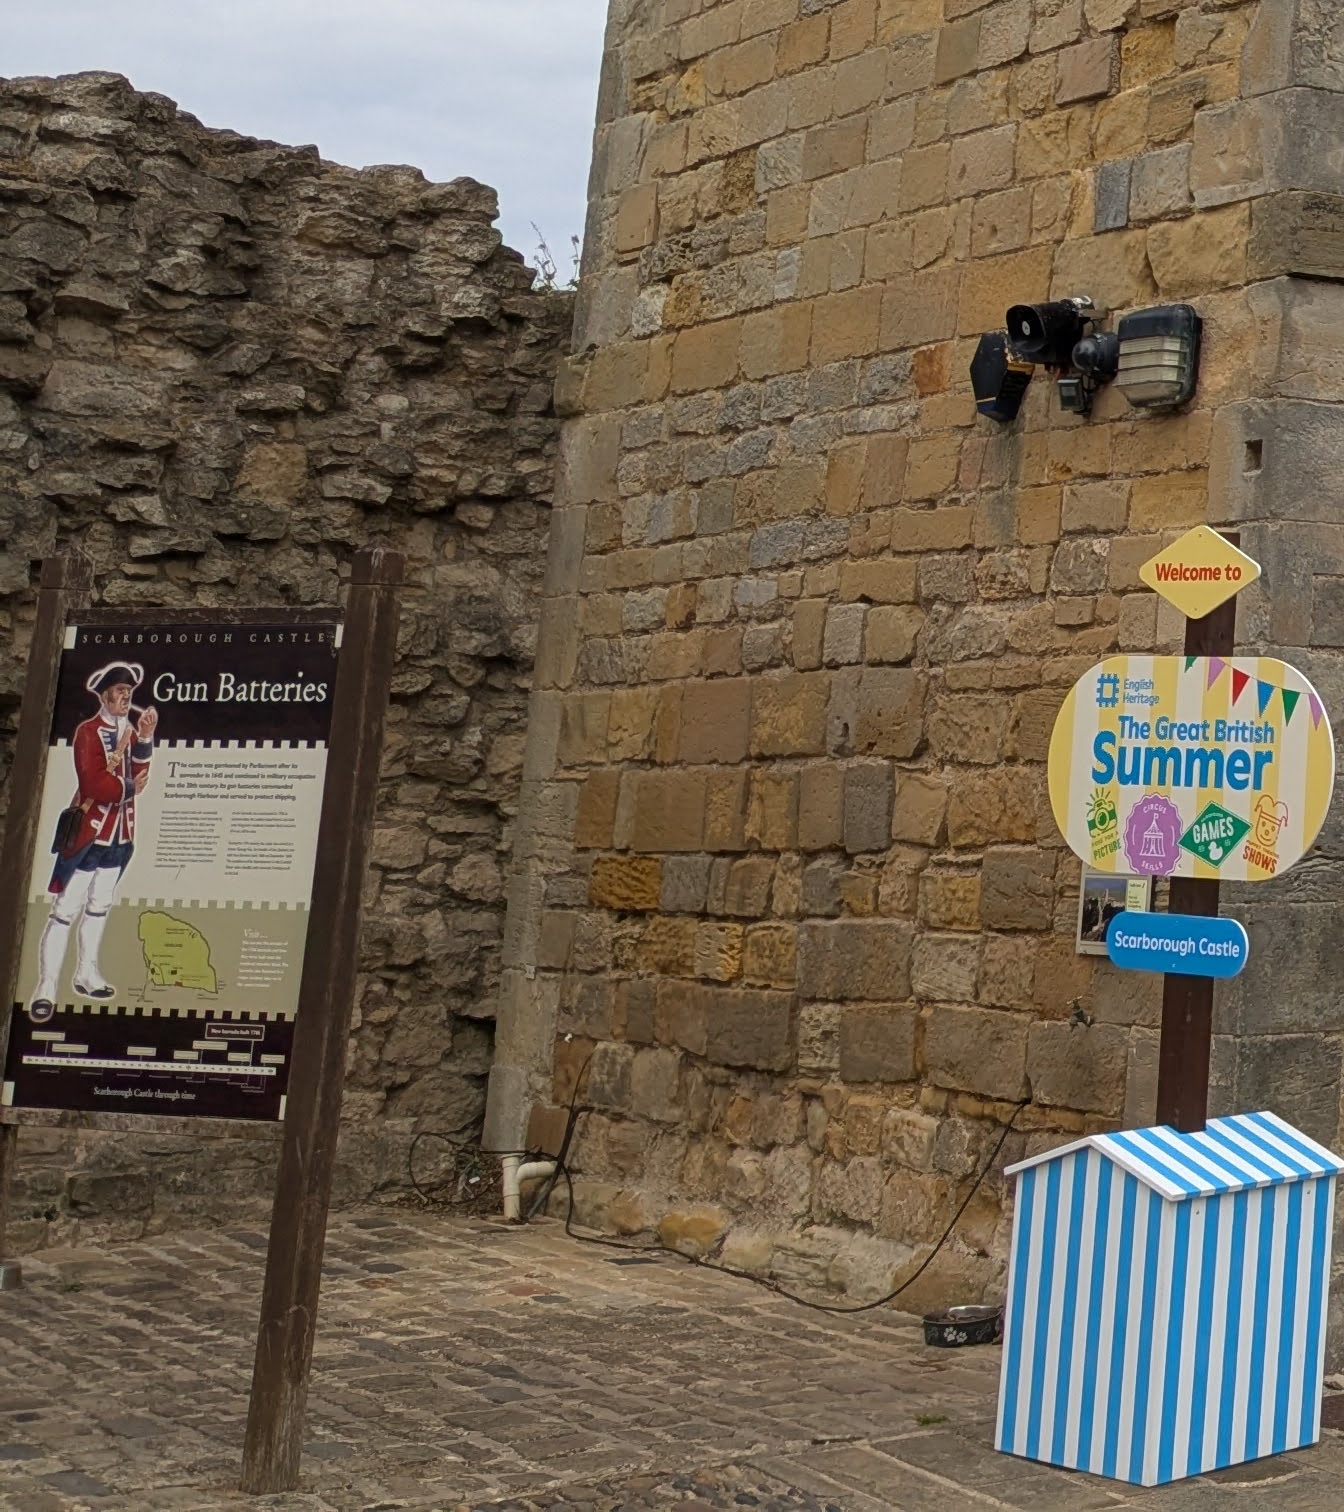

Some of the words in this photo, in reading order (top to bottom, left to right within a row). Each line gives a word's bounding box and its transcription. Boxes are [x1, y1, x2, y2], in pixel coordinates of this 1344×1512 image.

[1155, 563, 1222, 581] Welcome
[1224, 564, 1242, 581] to
[82, 633, 233, 644] SCARBOROUGH
[250, 633, 325, 643] CASTLE
[153, 672, 209, 703] Gun
[215, 671, 328, 703] Batteries
[1123, 678, 1155, 692] English
[1122, 693, 1160, 706] Heritage
[1118, 715, 1151, 740] The
[1155, 715, 1210, 742] Great
[1214, 719, 1275, 744] British
[1091, 730, 1273, 791] Summer
[1142, 803, 1167, 814] CIRCUS
[1192, 816, 1234, 844] GAMES
[1093, 838, 1122, 861] PICTURE
[1243, 845, 1277, 874] SHOWS
[1114, 930, 1196, 957] Scarborough
[1199, 937, 1240, 958] Castle
[94, 1086, 133, 1099] Scarborough
[133, 1088, 153, 1098] Castle
